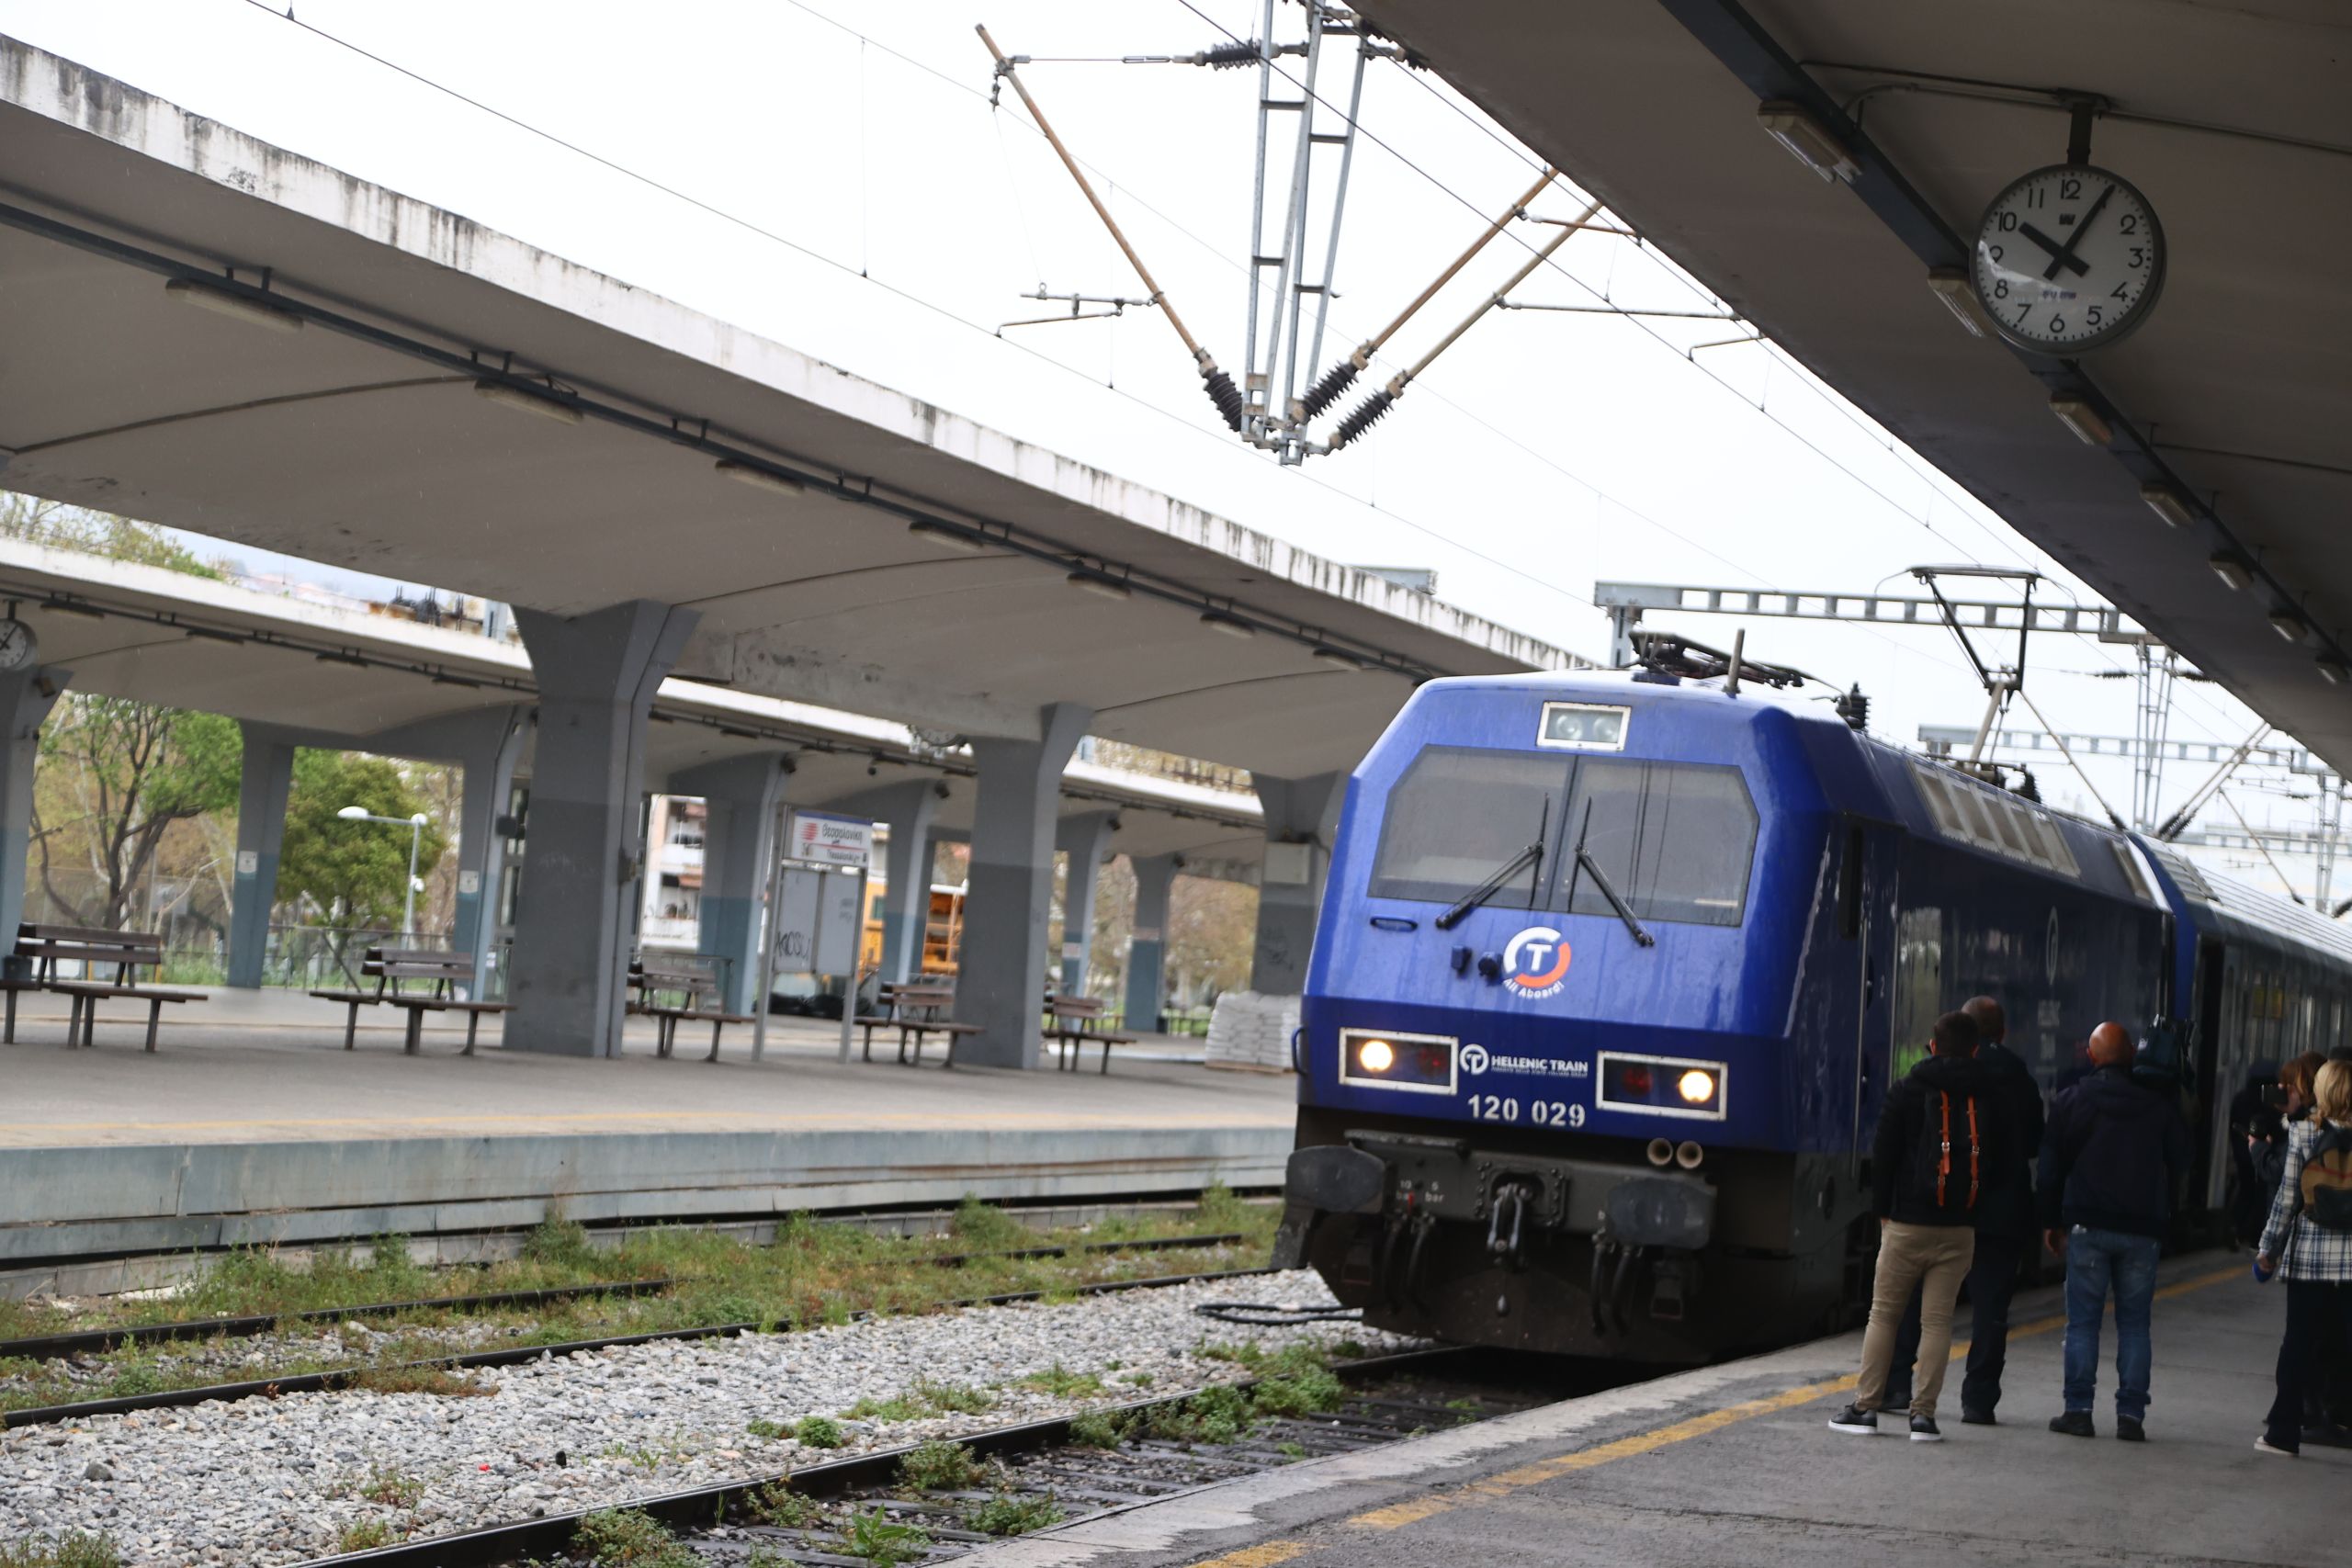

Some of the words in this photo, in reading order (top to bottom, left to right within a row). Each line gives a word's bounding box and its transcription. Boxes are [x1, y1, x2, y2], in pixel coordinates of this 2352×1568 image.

[2028, 187, 2044, 209] 11
[2060, 179, 2081, 200] 12
[1998, 211, 2018, 232] 10
[2120, 214, 2136, 235] 2
[2128, 248, 2143, 268] 3
[1994, 279, 2009, 299] 8
[2110, 281, 2129, 302] 4
[2017, 303, 2032, 323] 7
[2049, 312, 2065, 333] 6
[2086, 306, 2103, 325] 5
[1503, 977, 1517, 992] All
[1518, 980, 1565, 999] Aboard!
[1491, 1055, 1548, 1070] HELLENIC
[1550, 1059, 1589, 1072] TRAIN
[1467, 1094, 1519, 1122] 120
[1531, 1100, 1586, 1128] 029
[1425, 1190, 1445, 1202] bar
